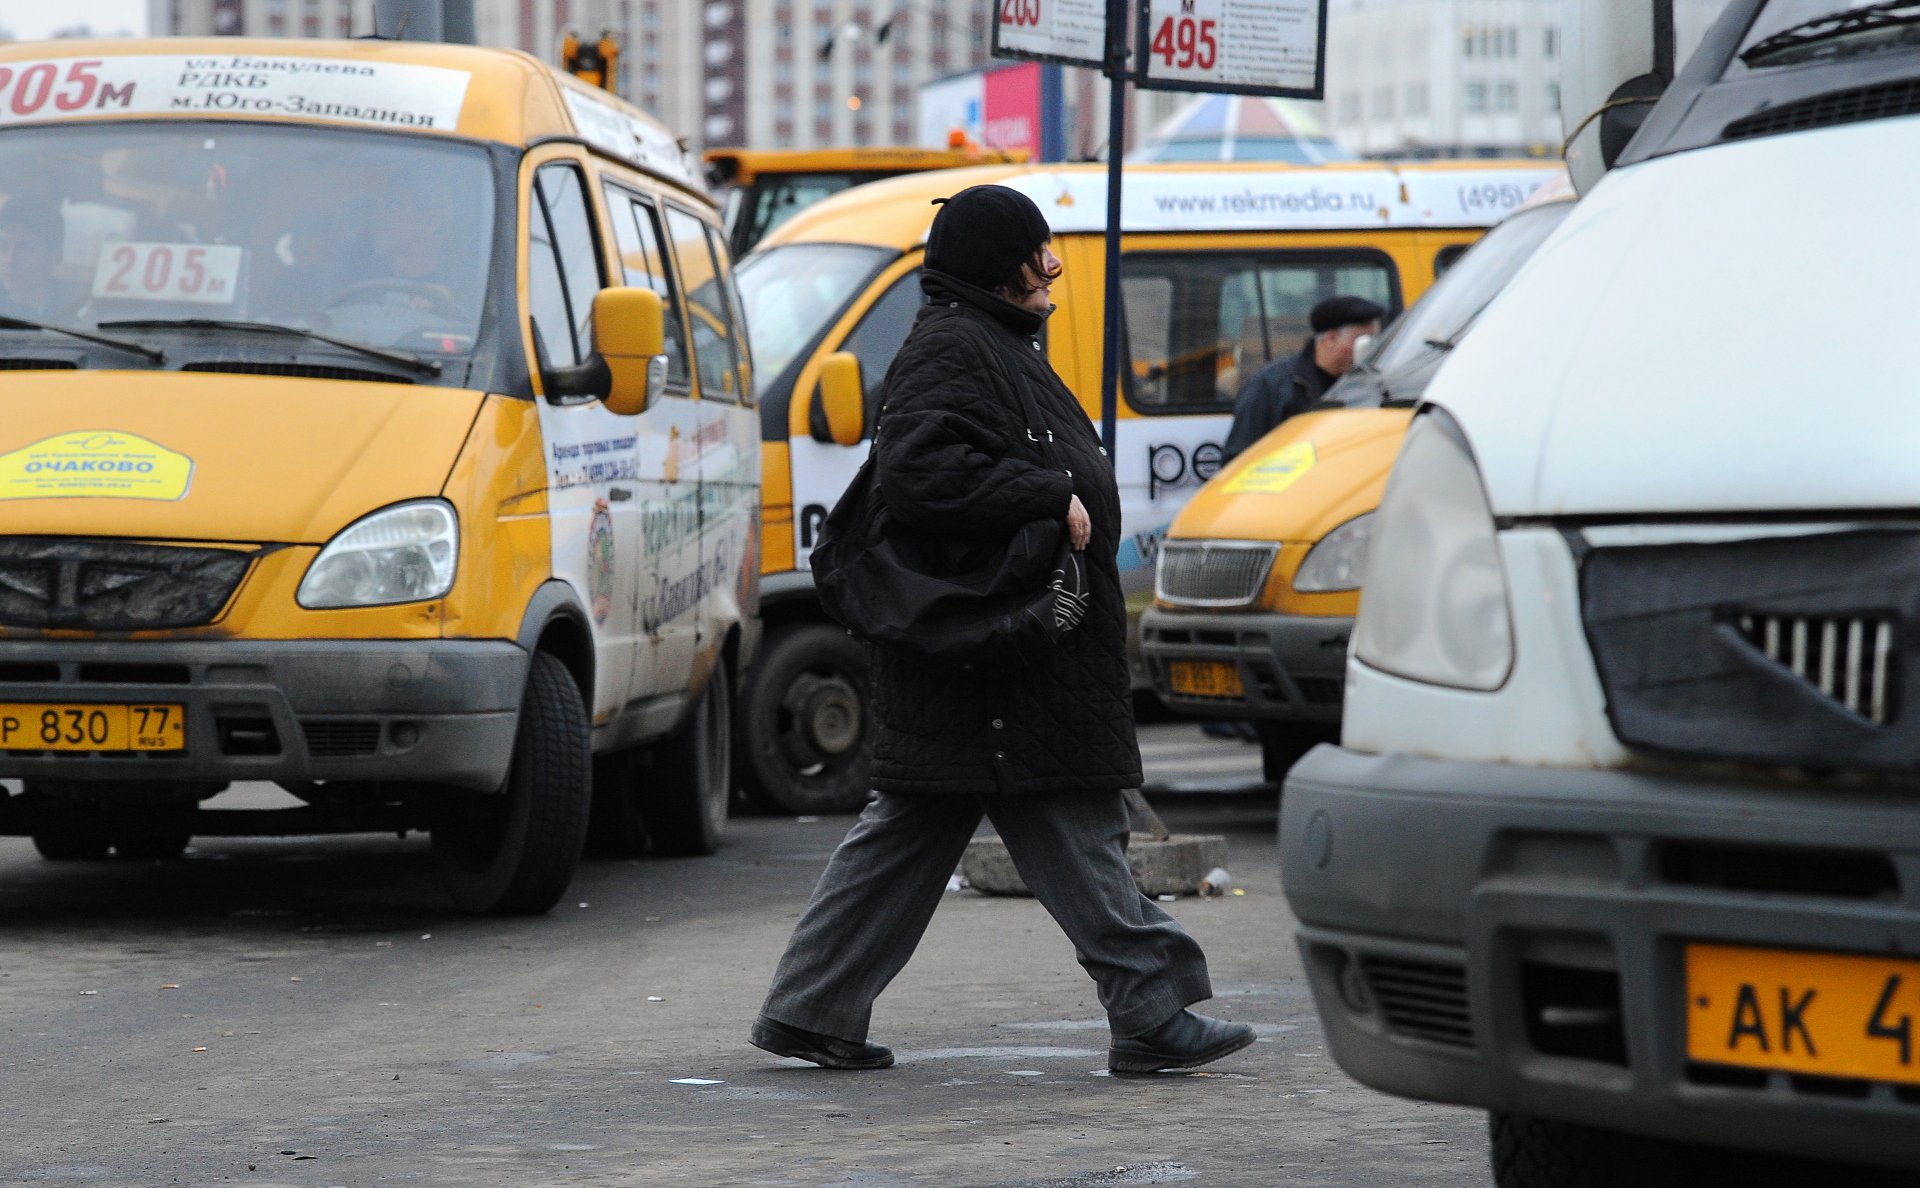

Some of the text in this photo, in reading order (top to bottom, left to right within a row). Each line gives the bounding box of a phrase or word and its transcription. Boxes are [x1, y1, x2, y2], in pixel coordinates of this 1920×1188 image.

[1152, 16, 1217, 70] 495
[178, 71, 270, 89] РДКБ
[170, 91, 436, 128] м.Юго-Западная
[1153, 187, 1377, 213] www.rekmedia.ru
[25, 460, 154, 474] ОЧАКОВО
[41, 709, 109, 745] 830
[134, 707, 170, 735] 77
[138, 737, 166, 747] RUS
[1727, 982, 1818, 1057] АК
